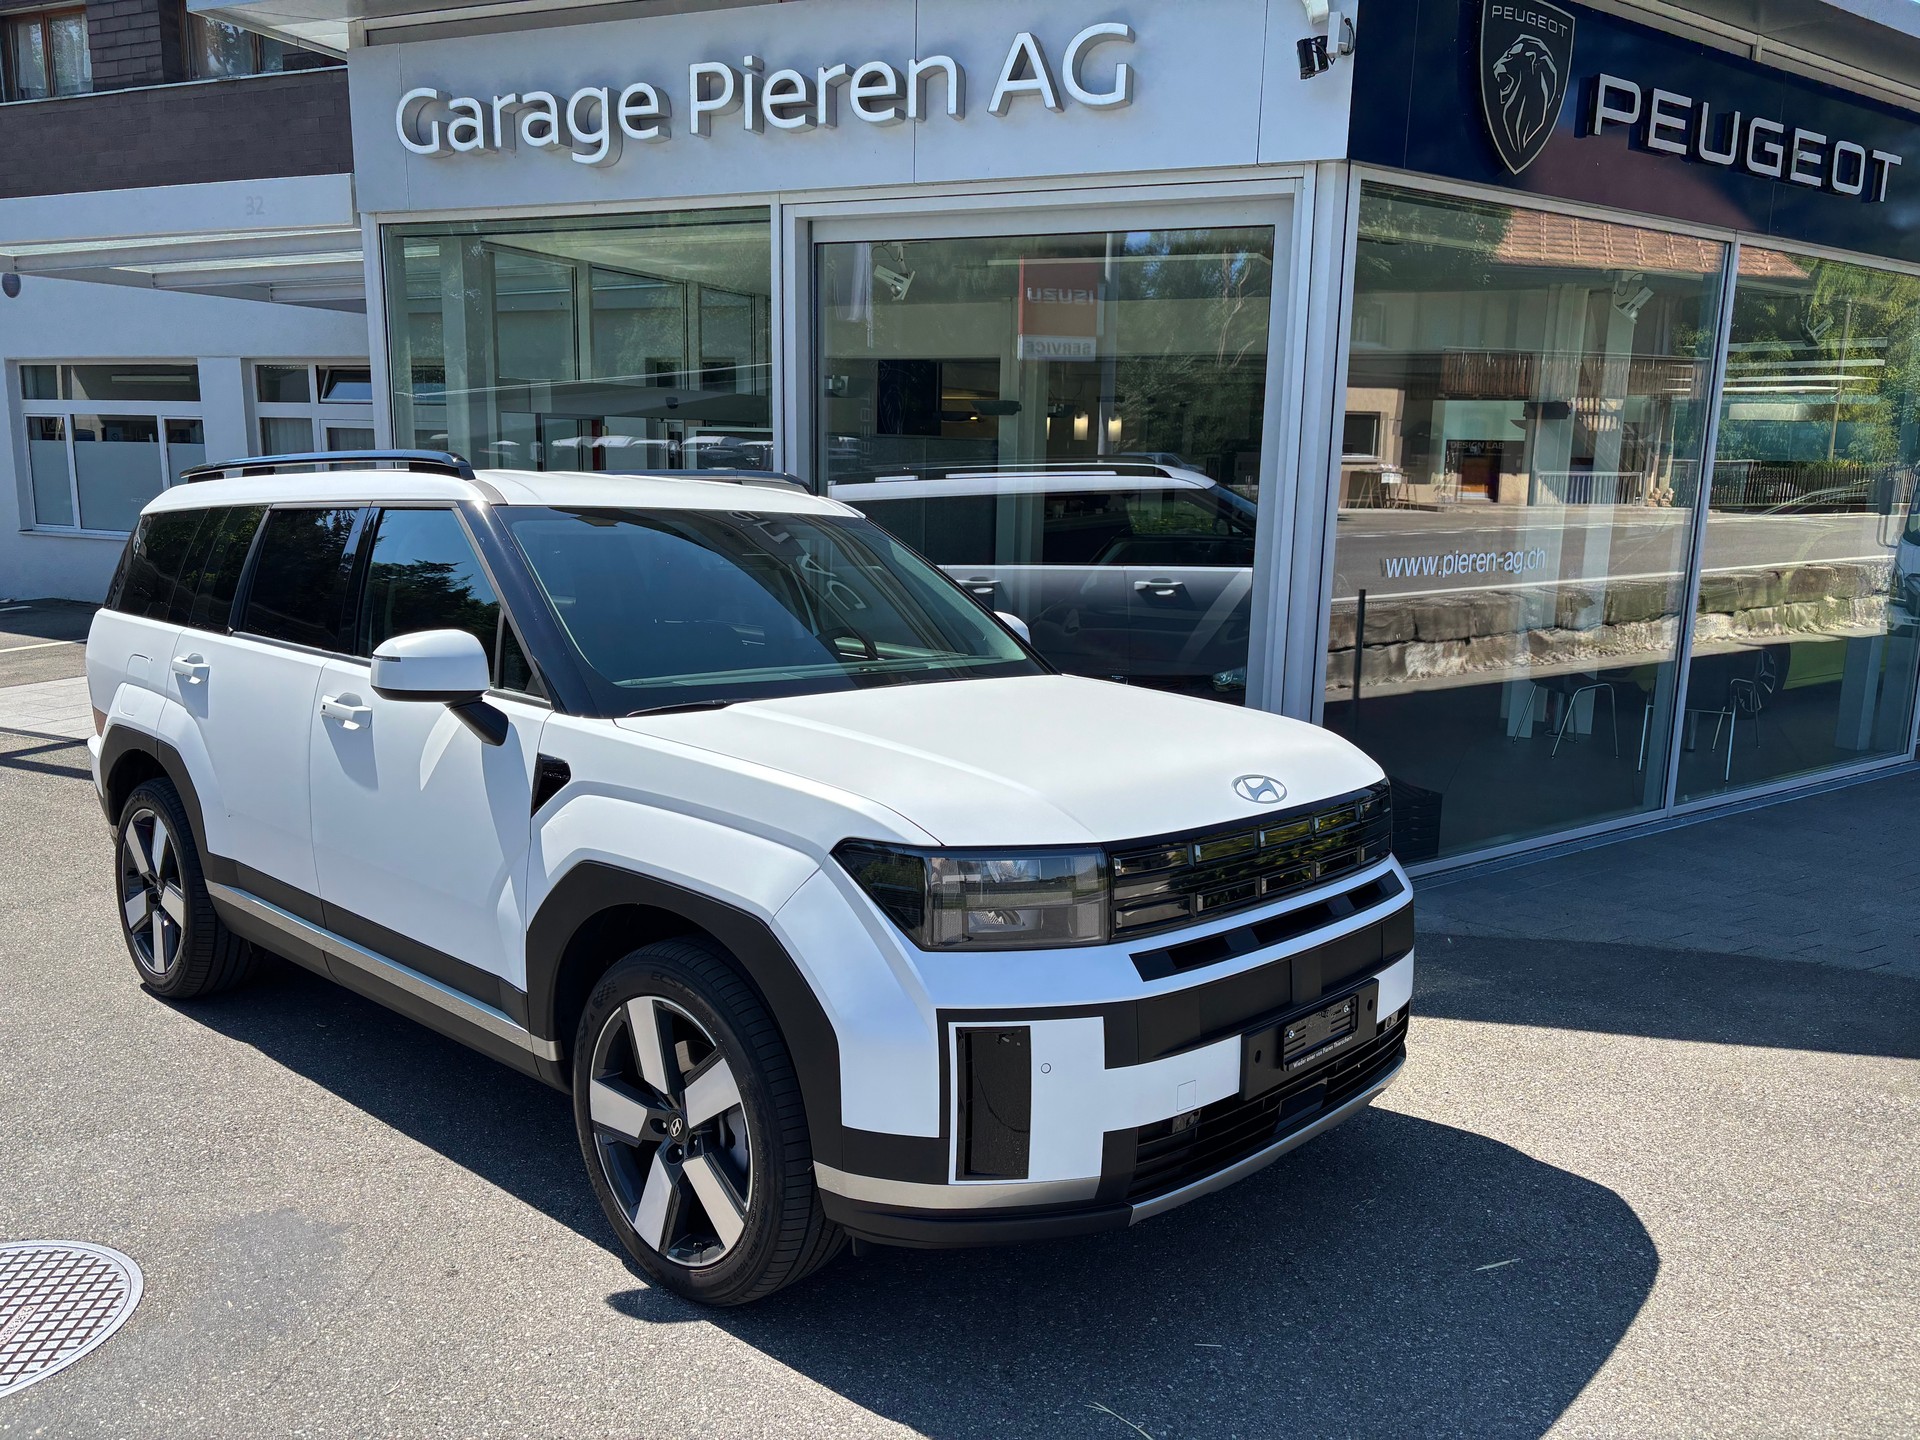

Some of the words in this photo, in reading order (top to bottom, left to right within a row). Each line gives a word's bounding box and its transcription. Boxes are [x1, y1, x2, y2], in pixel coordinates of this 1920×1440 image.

[1491, 5, 1568, 37] PEUGEOT
[395, 81, 670, 167] Garage
[689, 55, 965, 138] Pieren
[987, 22, 1135, 118] AG
[1593, 72, 1903, 203] PEUGEOT
[245, 195, 266, 216] 32
[1486, 442, 1505, 450] LAB
[1385, 547, 1546, 578] www.pieren-ag.ch
